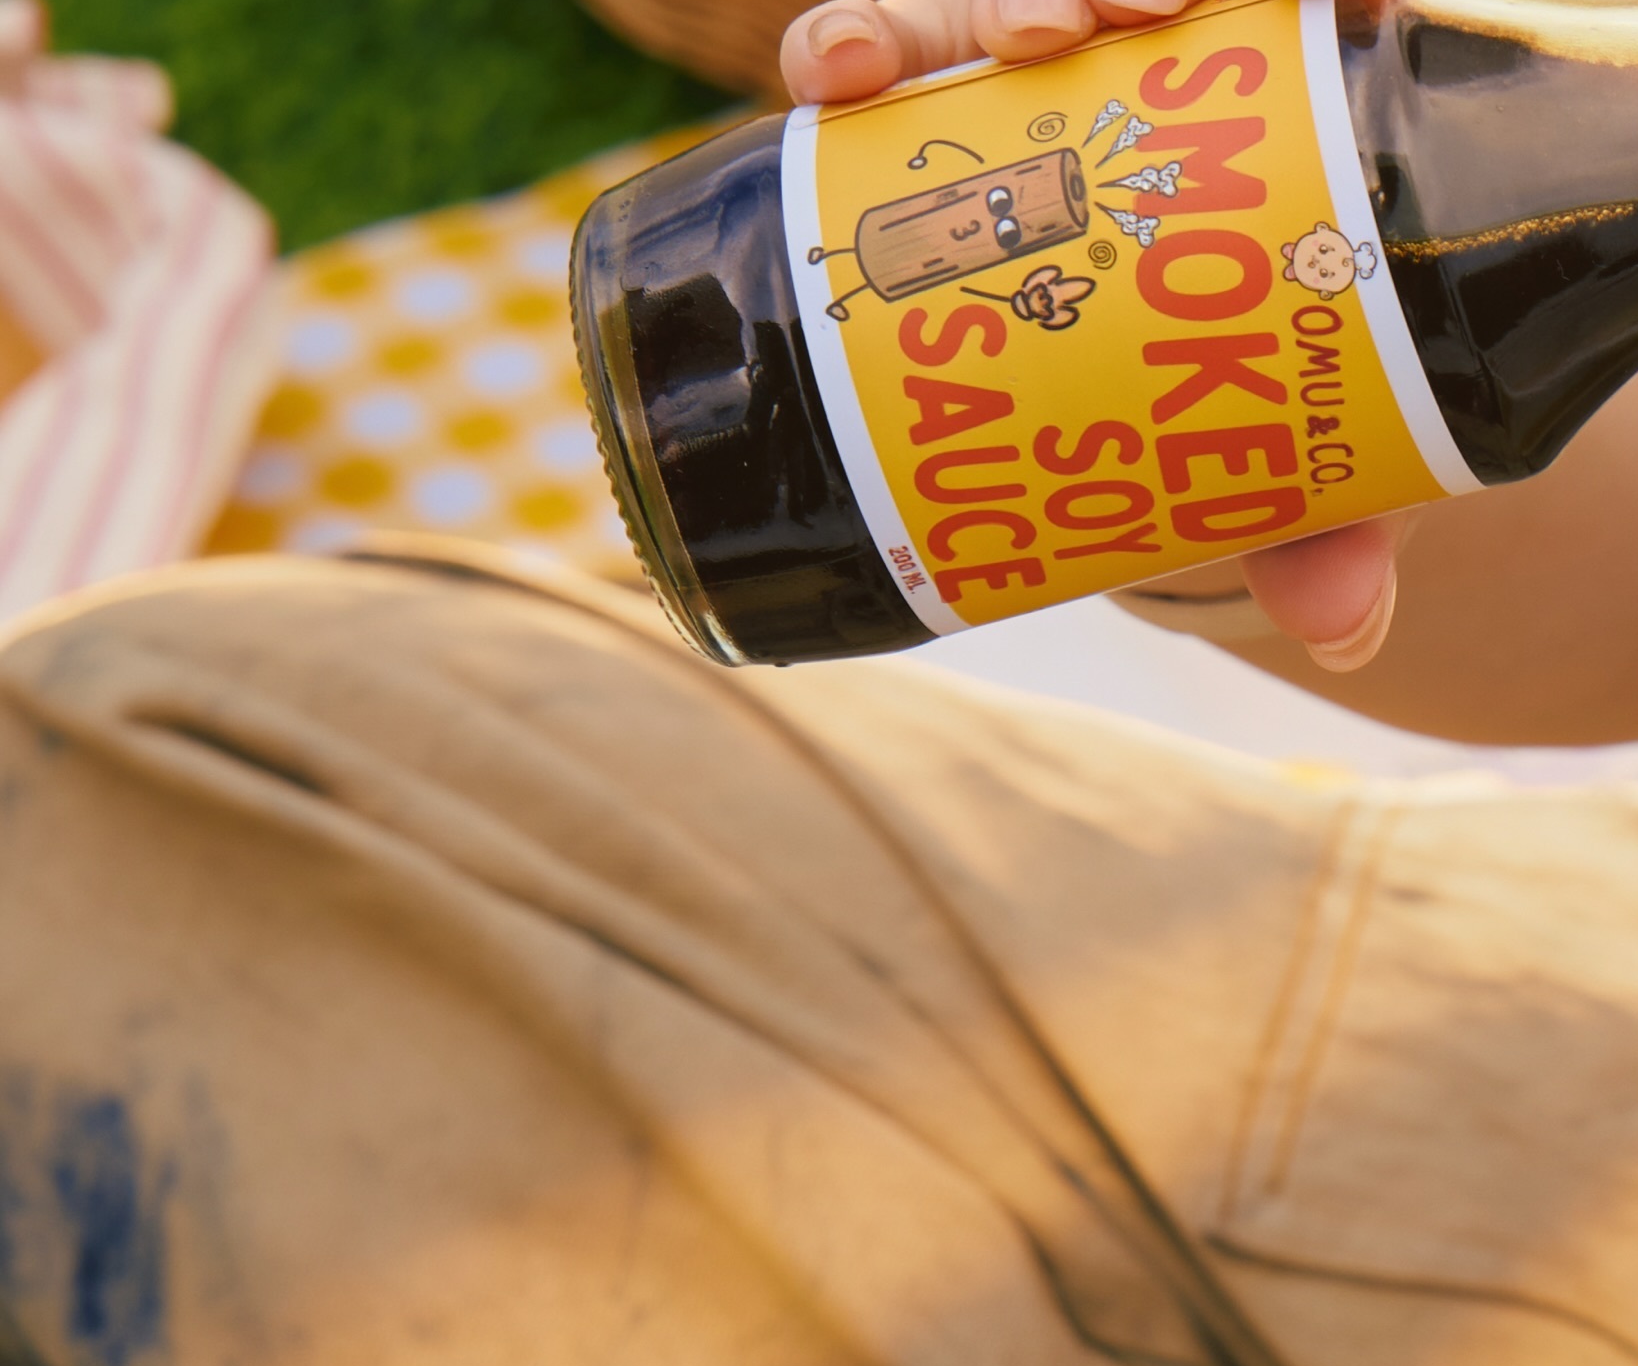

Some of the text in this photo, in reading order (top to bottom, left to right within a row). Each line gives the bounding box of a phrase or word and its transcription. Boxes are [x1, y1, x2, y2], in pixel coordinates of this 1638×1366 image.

[1133, 46, 1307, 544] SMOKED
[889, 545, 917, 572] 200
[898, 304, 1046, 604] SAUCE
[1032, 420, 1163, 561] SOY
